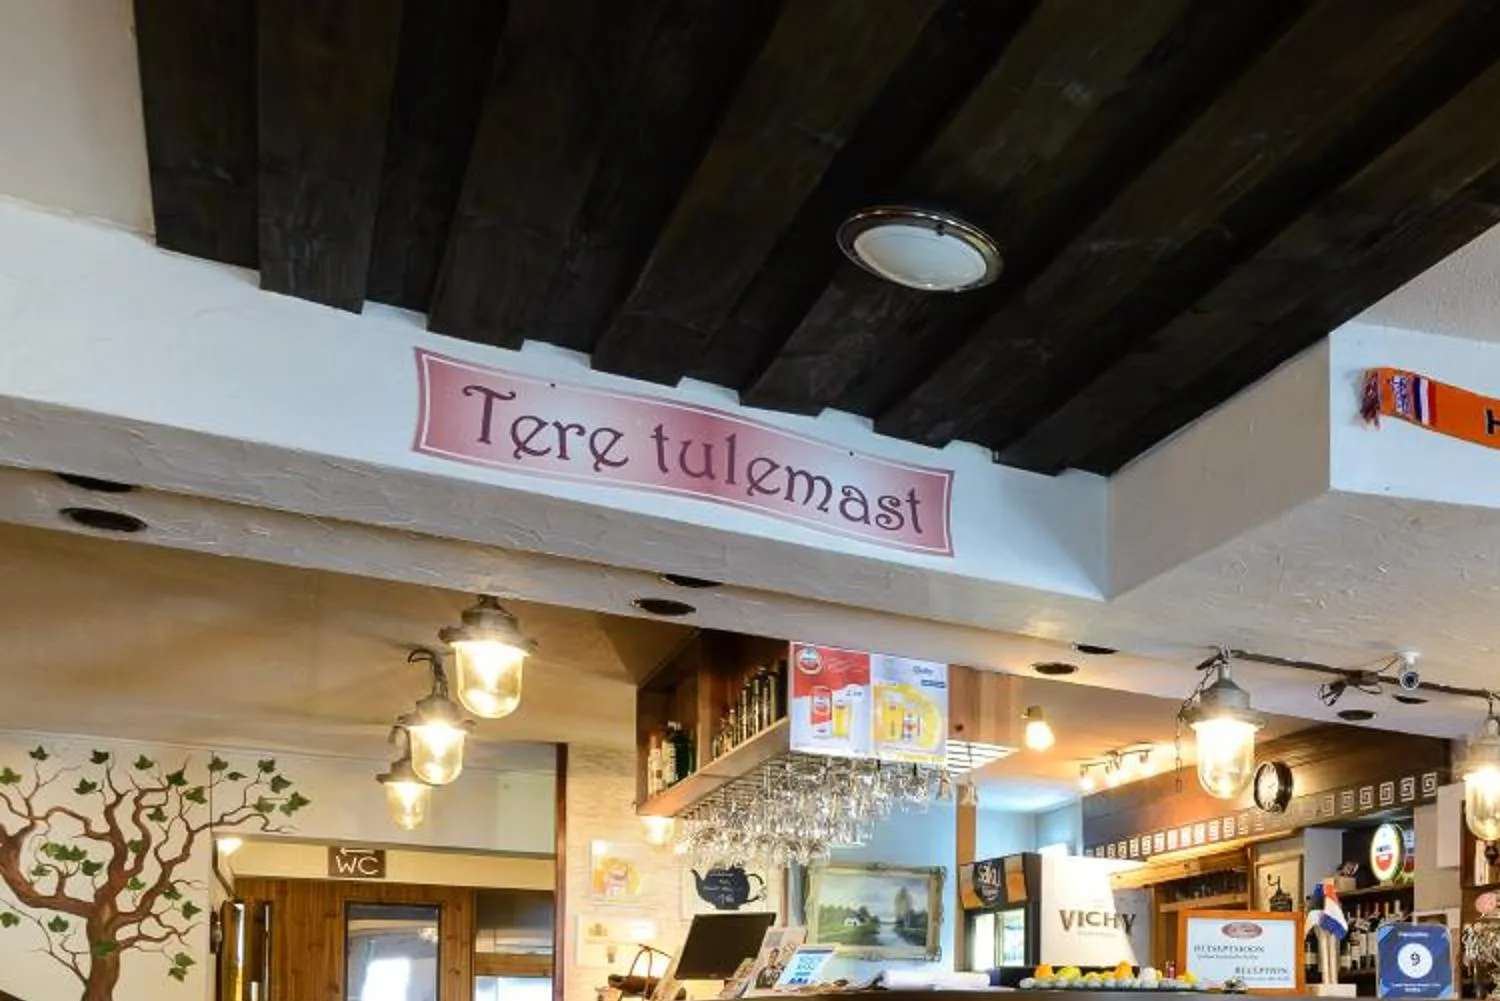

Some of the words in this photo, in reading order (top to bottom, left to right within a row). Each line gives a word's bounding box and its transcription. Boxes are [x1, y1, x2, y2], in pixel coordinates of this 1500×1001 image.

[463, 384, 629, 472] Tere
[650, 423, 923, 534] tulemast
[335, 855, 379, 875] WC
[1058, 908, 1137, 936] VICHY
